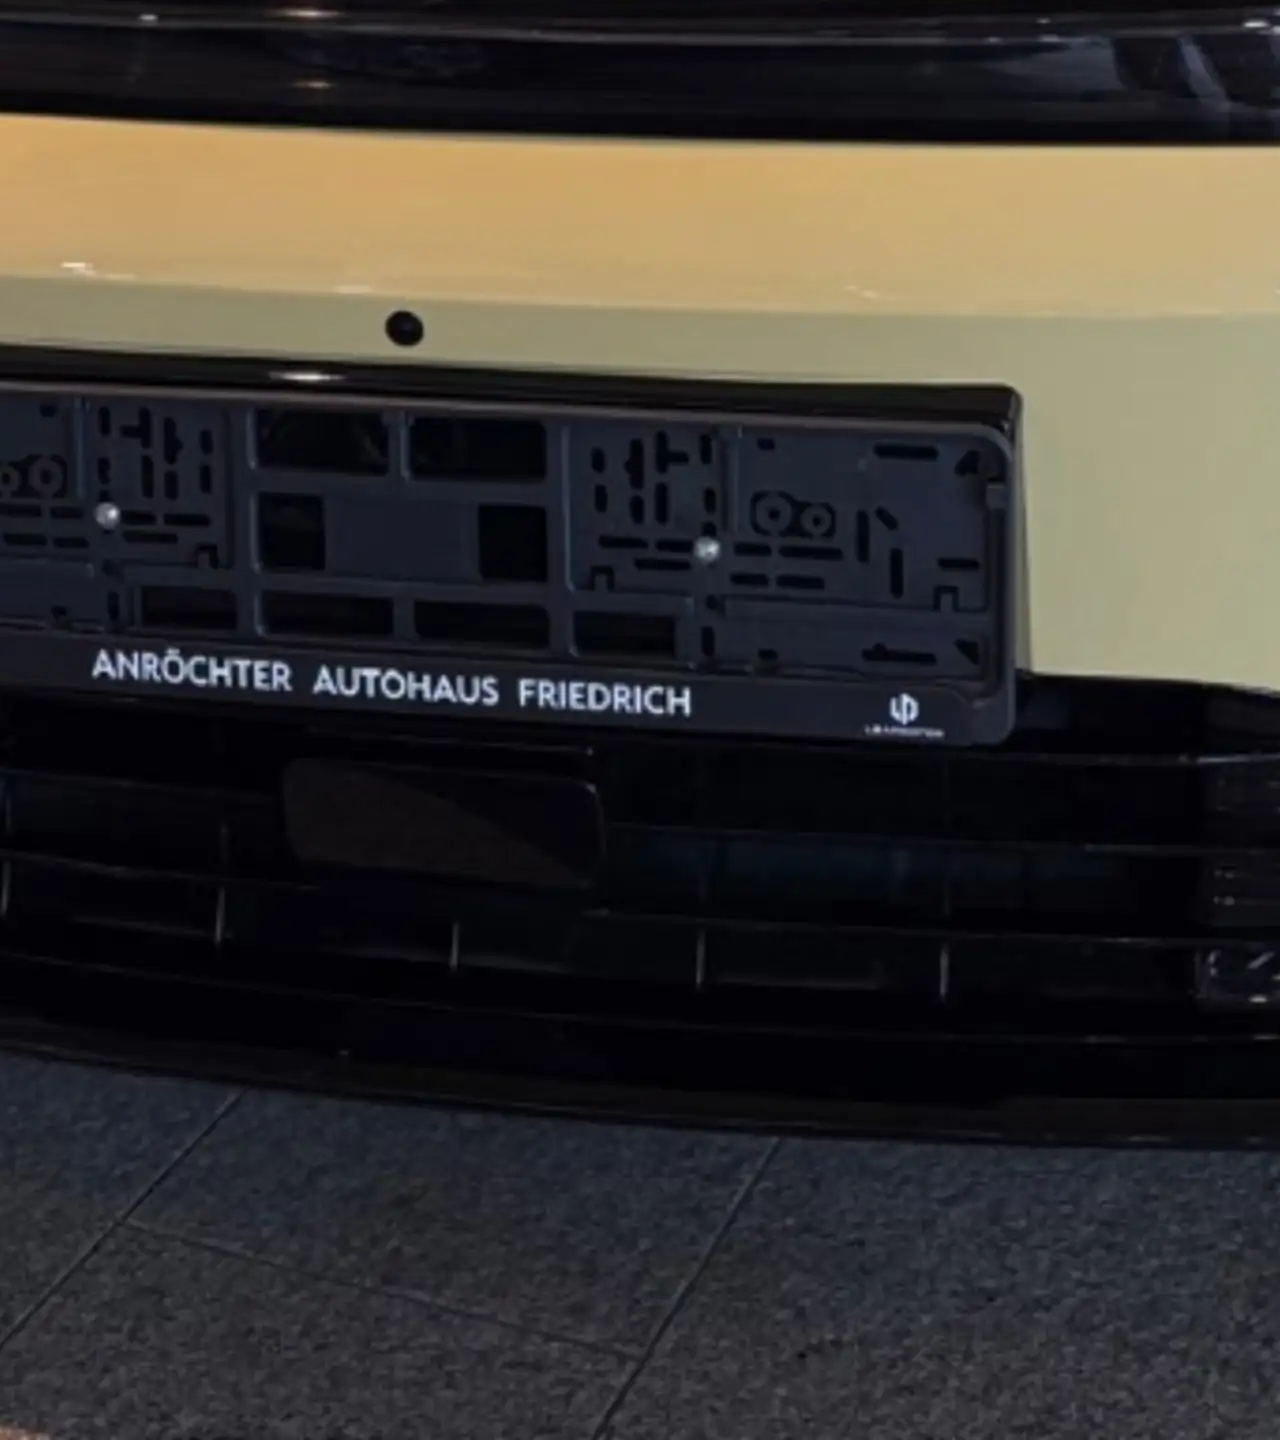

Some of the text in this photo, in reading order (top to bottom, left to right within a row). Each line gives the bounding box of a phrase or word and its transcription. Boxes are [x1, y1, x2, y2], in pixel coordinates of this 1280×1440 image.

[91, 648, 692, 717] ANRÖCHTER AUTOHAUS FRIEDRICH
